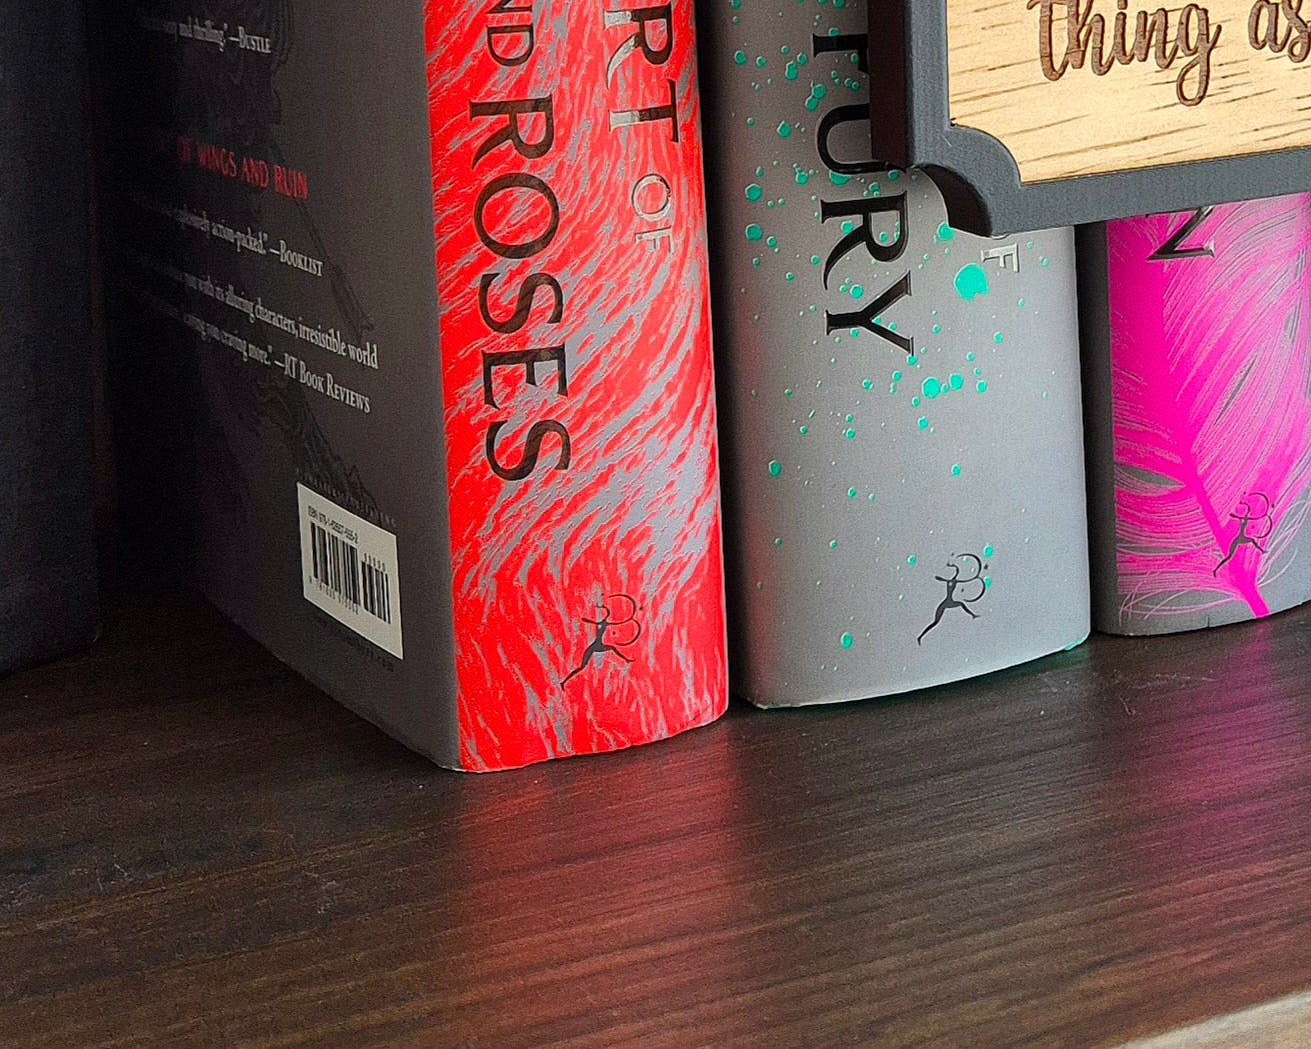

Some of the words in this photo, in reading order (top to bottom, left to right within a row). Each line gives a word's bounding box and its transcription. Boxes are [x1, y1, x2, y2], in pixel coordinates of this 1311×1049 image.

[197, 142, 237, 179] WINGS
[241, 156, 270, 190] AND
[273, 164, 308, 200] RUIN
[630, 174, 674, 258] OF
[468, 98, 571, 483] ROSES
[255, 297, 299, 339] characters,
[299, 316, 347, 359] irresistible
[348, 342, 379, 370] world
[299, 361, 325, 393] BOOK
[326, 373, 371, 414] REVIEWS
